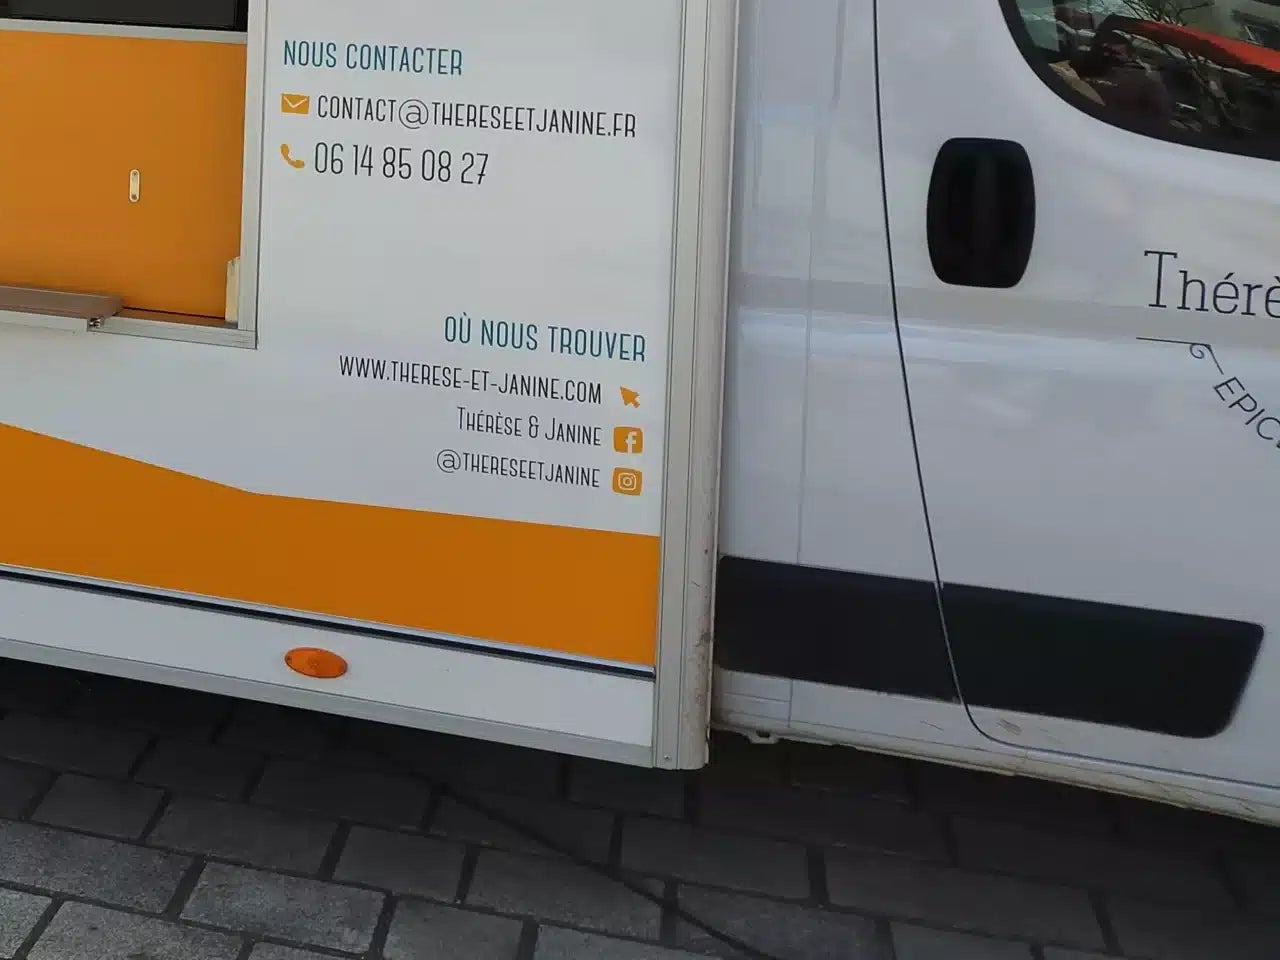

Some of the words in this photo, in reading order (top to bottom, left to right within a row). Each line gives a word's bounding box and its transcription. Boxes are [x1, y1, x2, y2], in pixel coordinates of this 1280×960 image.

[283, 40, 338, 68] NOUS
[346, 43, 464, 76] CONTACTER
[317, 95, 638, 138] CONTACT@THERESEETJANINE.FR
[314, 141, 344, 175] 06
[353, 144, 374, 178] 14
[382, 146, 412, 180] 85
[421, 149, 452, 183] 08
[461, 152, 489, 186] 27
[444, 312, 471, 343] OÙ
[481, 319, 538, 351] NOUS
[548, 325, 646, 362] TROUVER
[339, 354, 602, 405] WWW.THERESE-ET-JANINE.COM
[528, 415, 540, 439] &
[1213, 376, 1280, 449] EPIC
